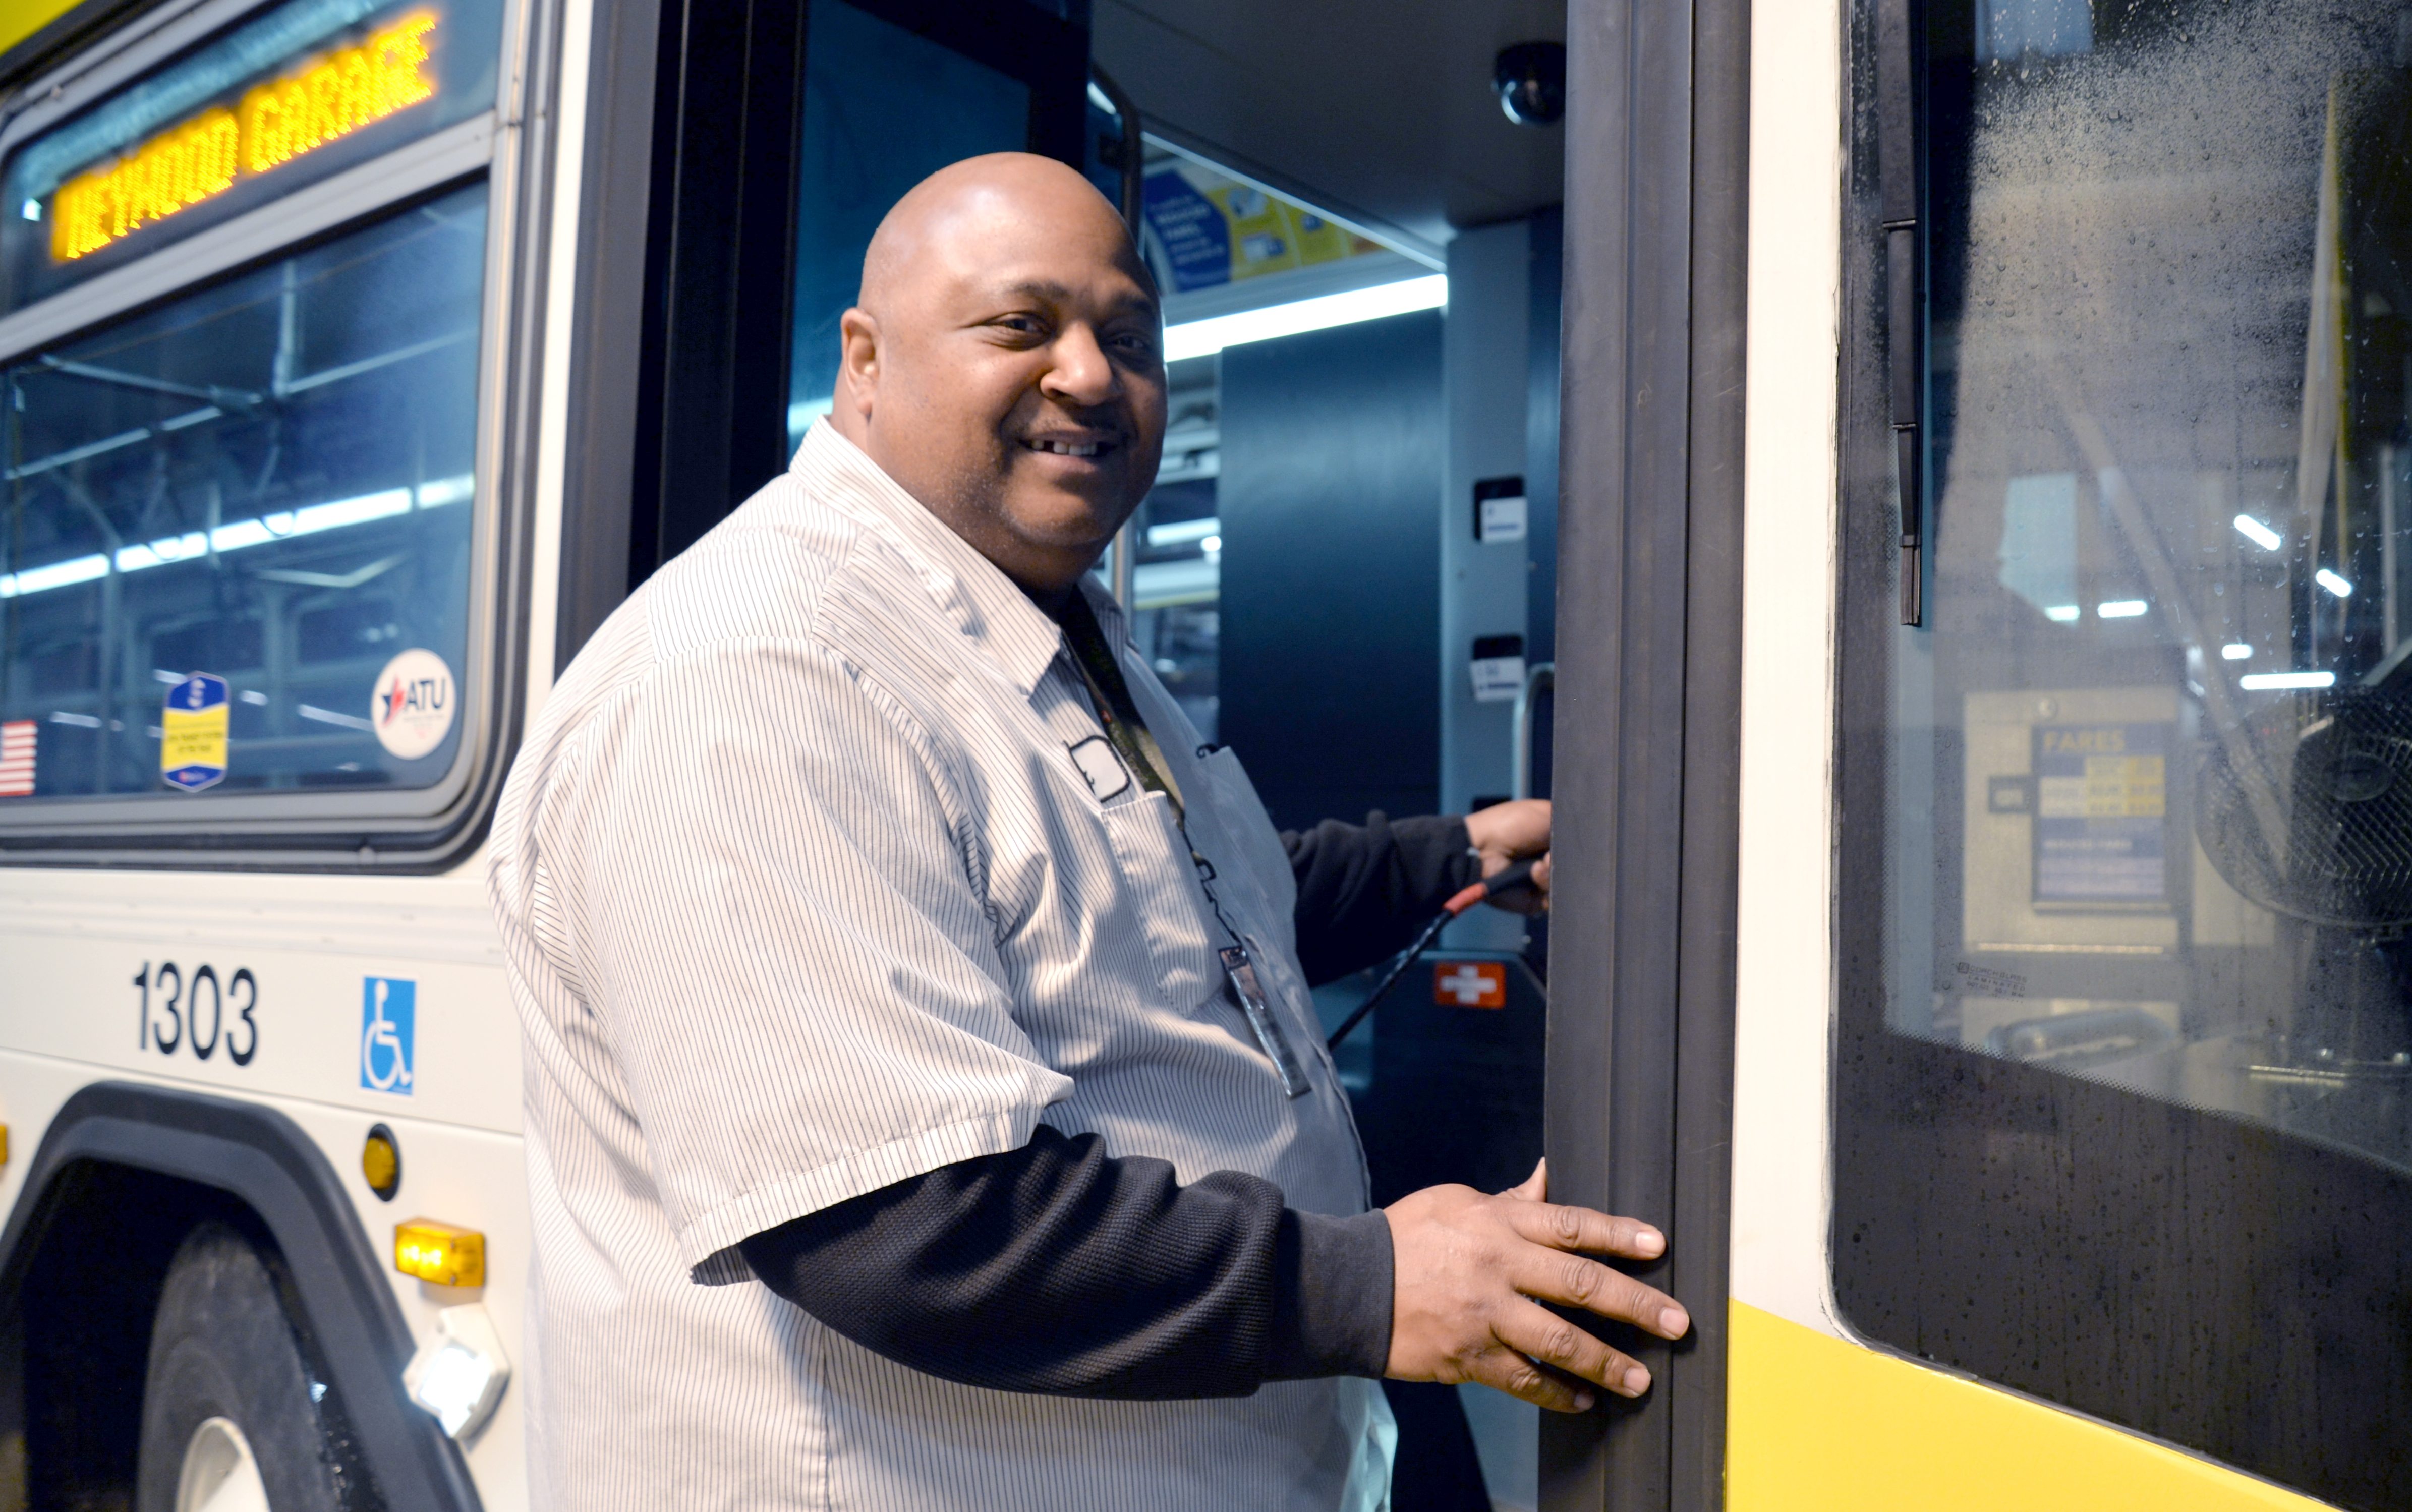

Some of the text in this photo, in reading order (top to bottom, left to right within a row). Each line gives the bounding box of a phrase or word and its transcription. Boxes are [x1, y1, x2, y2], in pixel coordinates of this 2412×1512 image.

[246, 15, 437, 172] GARAGE
[404, 678, 445, 711] ATU
[2044, 729, 2125, 753] FARES
[133, 961, 259, 1067] 1303
